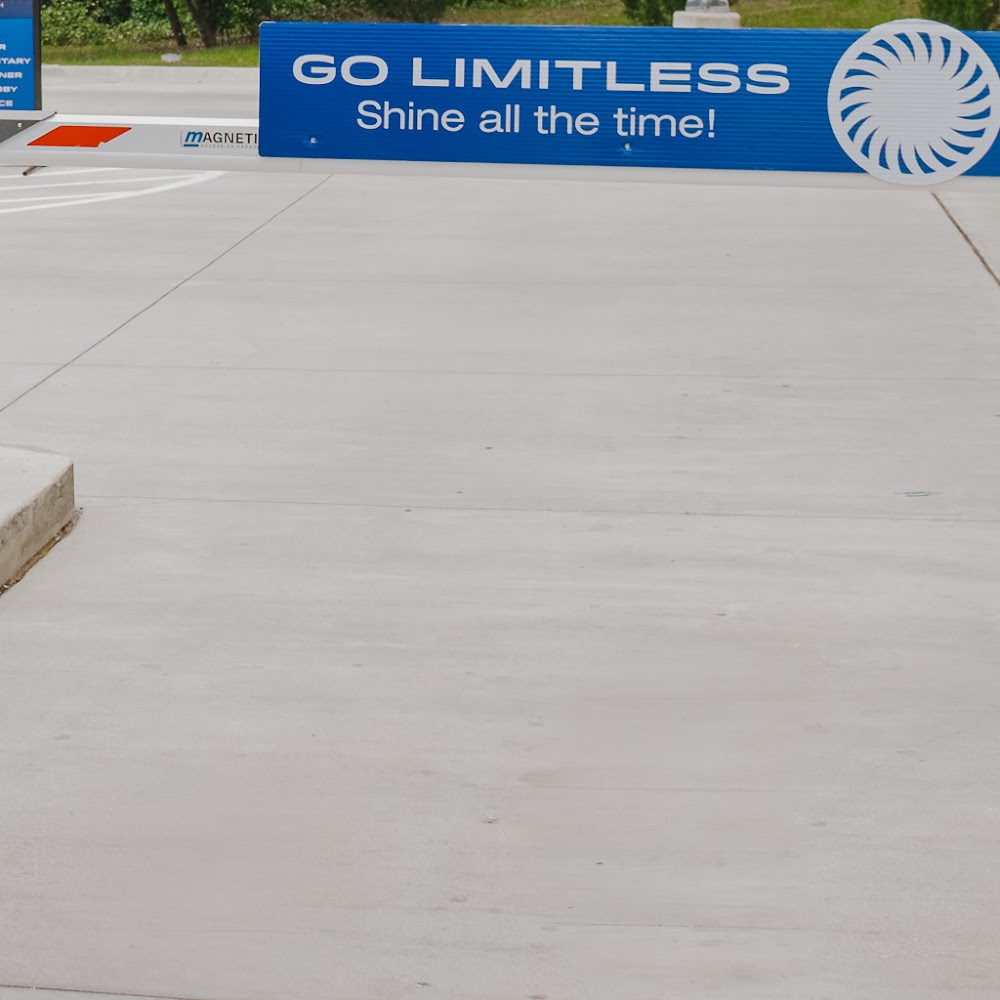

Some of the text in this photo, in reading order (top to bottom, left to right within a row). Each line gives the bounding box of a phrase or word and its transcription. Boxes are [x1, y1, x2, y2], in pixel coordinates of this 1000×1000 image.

[292, 54, 790, 94] GO LIMITLESS
[184, 131, 258, 144] mAGNETI
[356, 100, 716, 139] Shine all the time!
